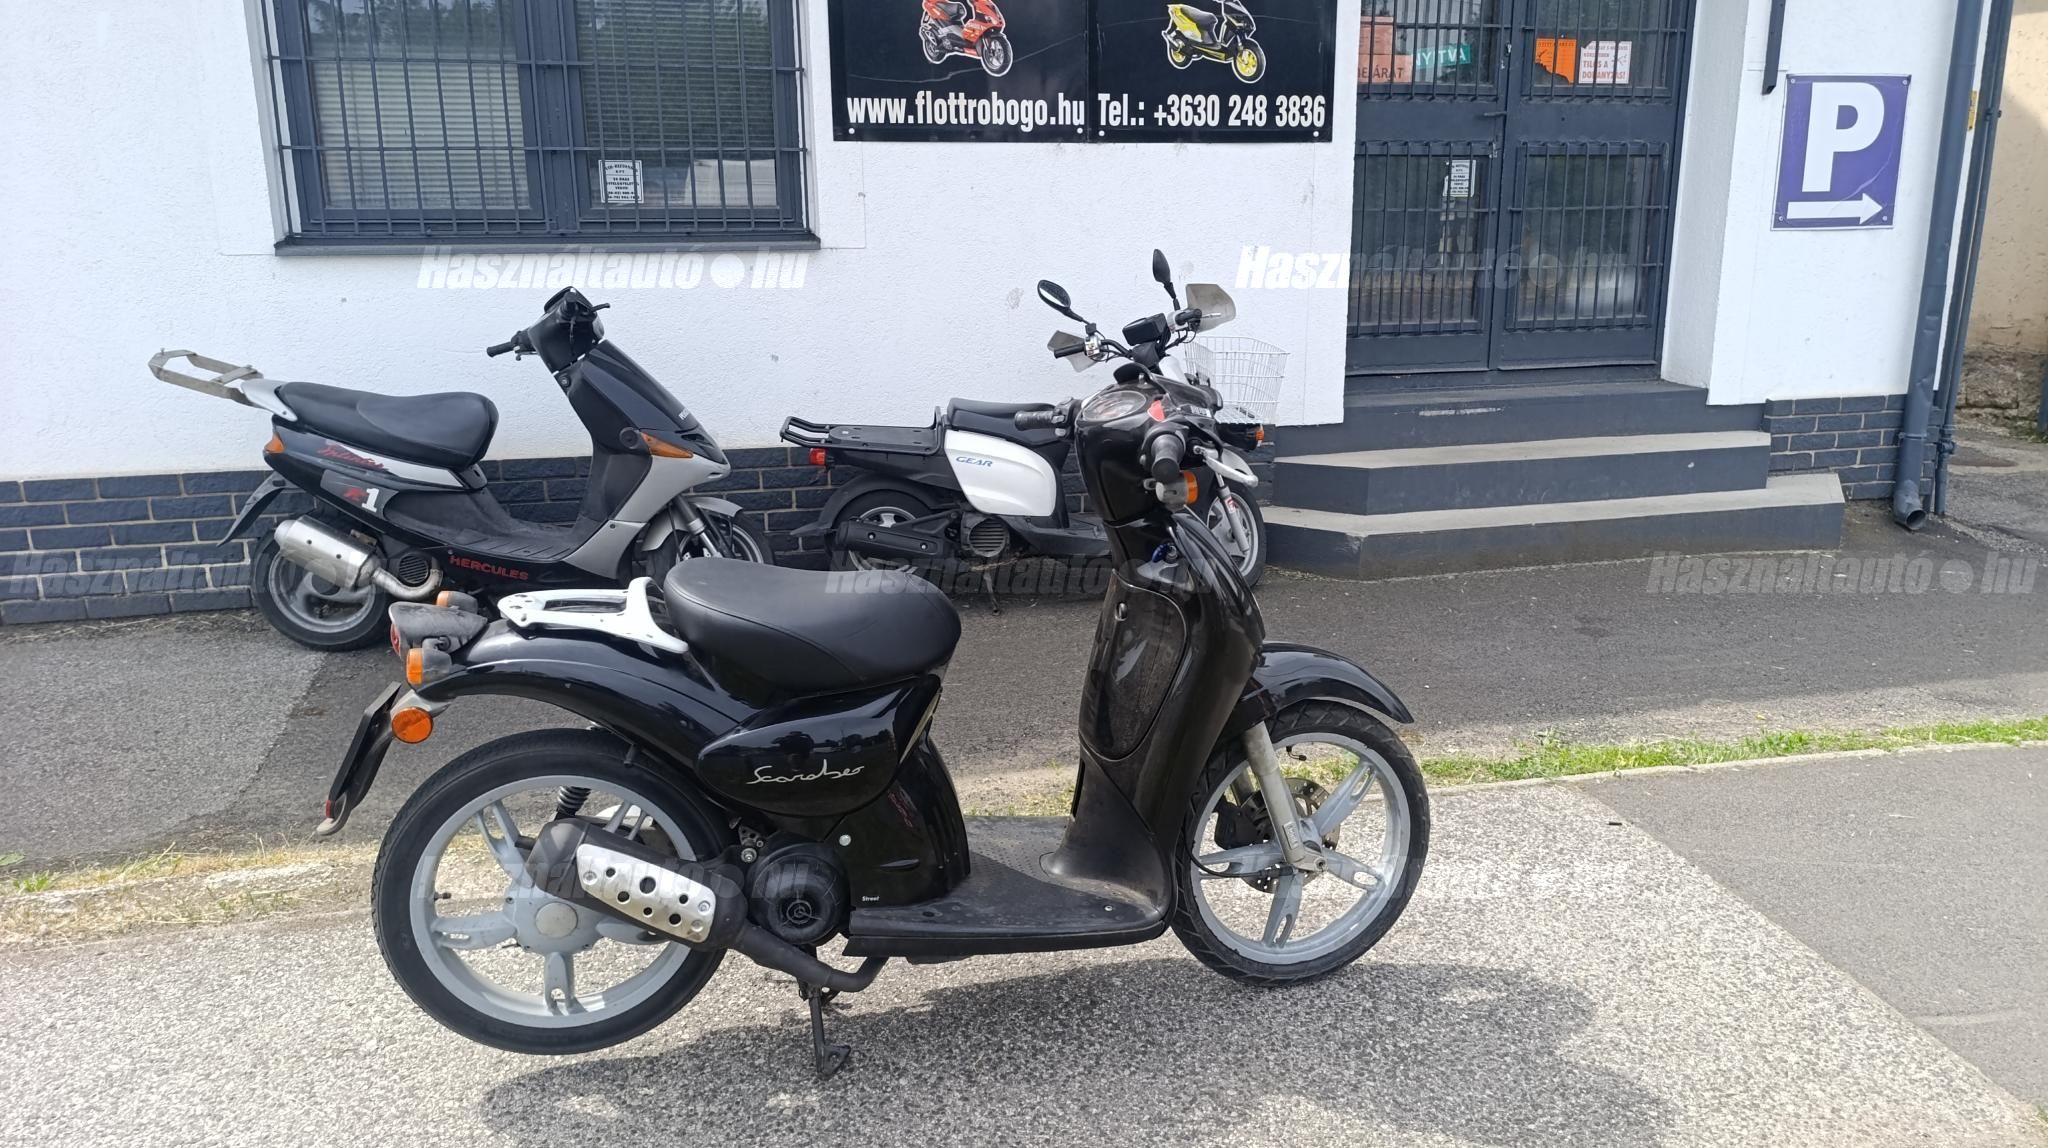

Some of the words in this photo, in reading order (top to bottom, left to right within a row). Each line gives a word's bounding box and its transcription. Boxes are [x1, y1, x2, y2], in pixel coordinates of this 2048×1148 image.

[1415, 46, 1467, 66] NYTVA
[847, 90, 1085, 132] www.flottrobogo.hu
[1098, 93, 1145, 126] Tel.:
[1153, 94, 1220, 127] +3630
[1228, 95, 1268, 127] 248
[1275, 95, 1325, 128] 3836
[1802, 82, 1885, 193] P
[956, 456, 993, 467] GEAR
[449, 555, 529, 581] HERCULES
[746, 759, 865, 785] Scarabeo
